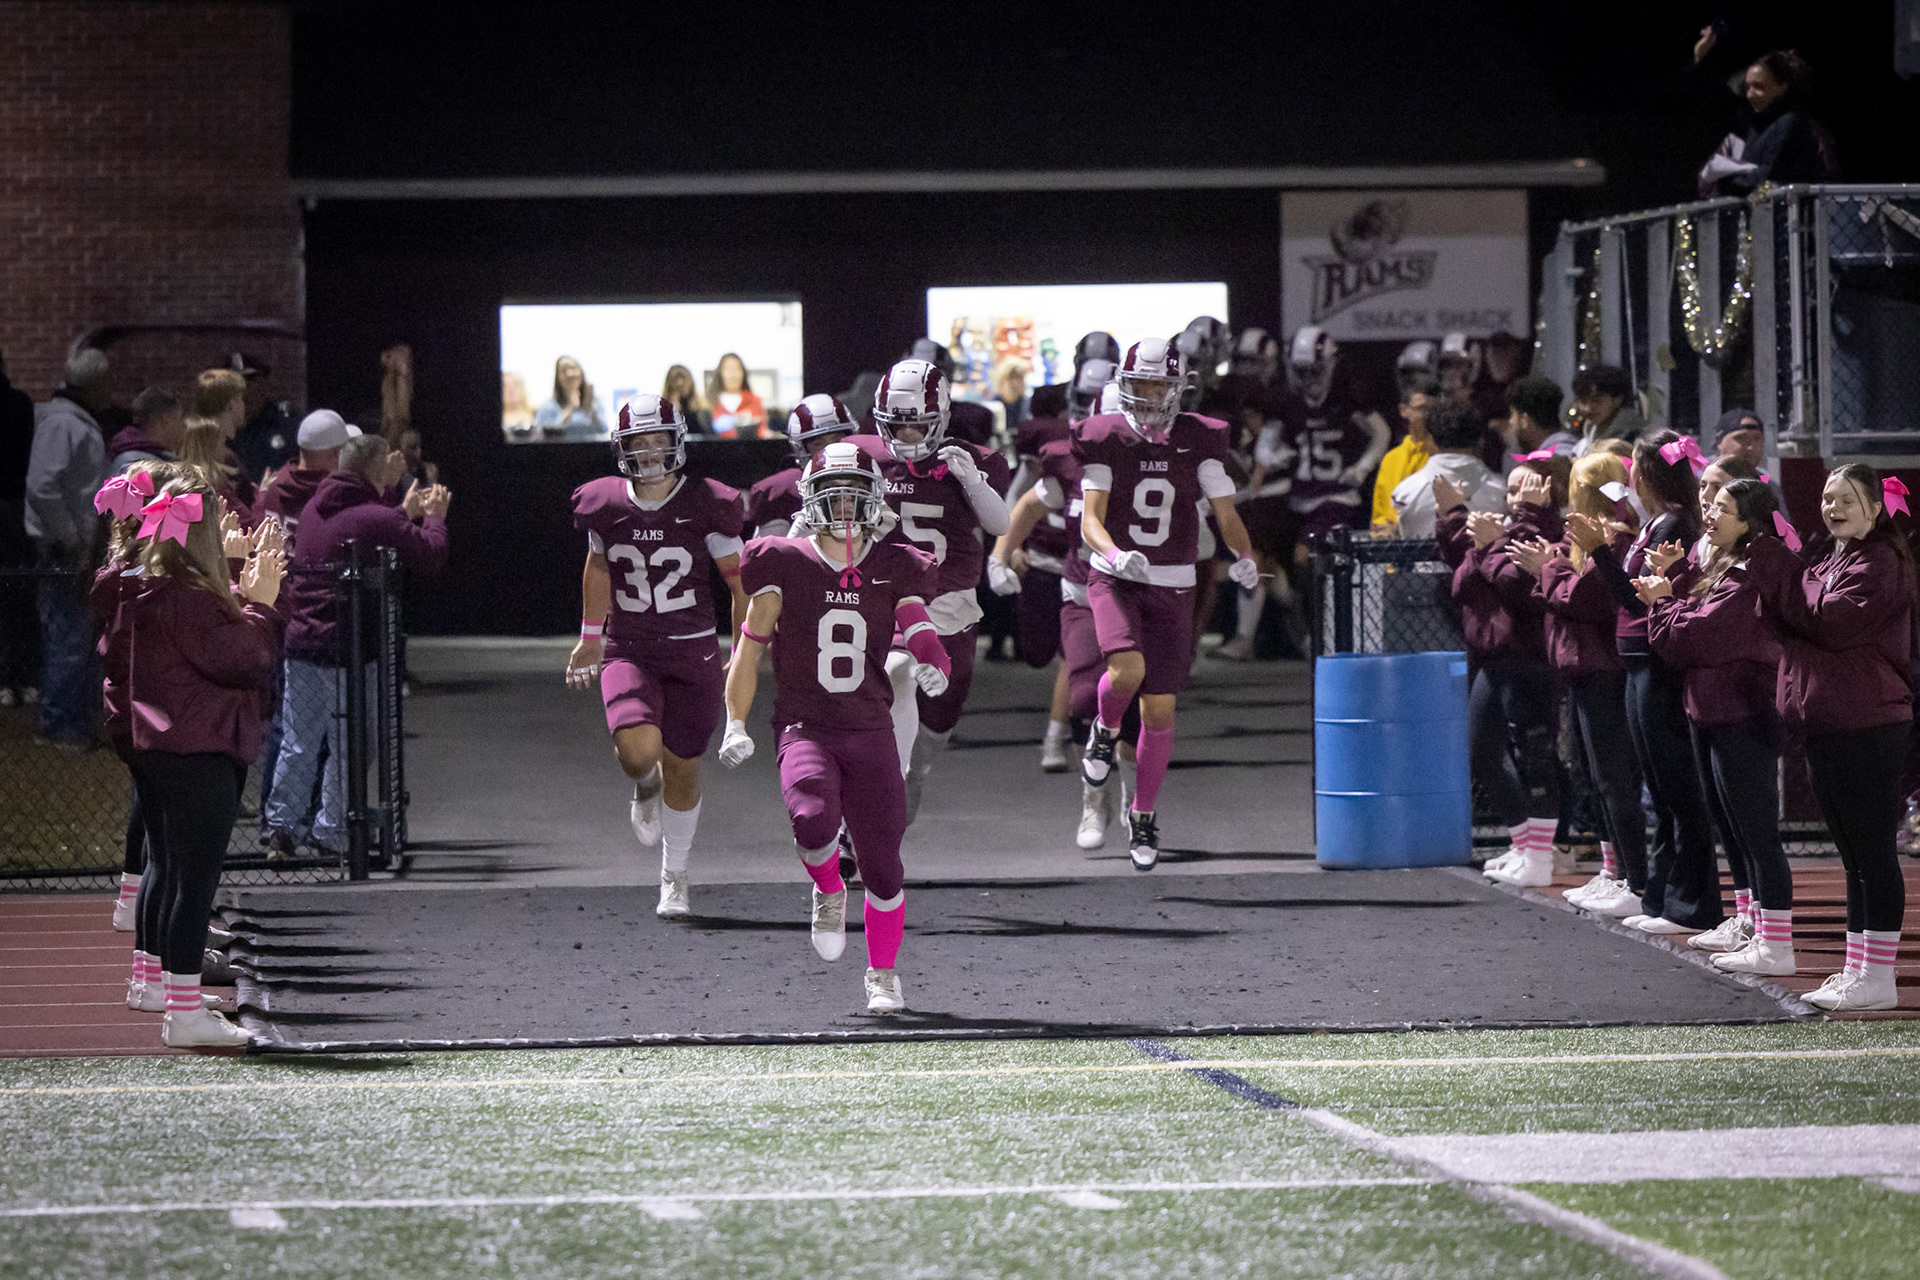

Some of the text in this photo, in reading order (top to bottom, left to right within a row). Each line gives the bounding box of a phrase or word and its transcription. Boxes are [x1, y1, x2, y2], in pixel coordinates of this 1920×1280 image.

[1312, 254, 1433, 313] RAMS
[1139, 460, 1169, 472] RAMS
[1295, 430, 1343, 481] 15
[885, 482, 915, 494] RAMS
[1128, 477, 1176, 547] 9
[632, 529, 664, 541] RAMS
[607, 543, 698, 614] 32
[824, 590, 860, 605] RAMS
[817, 608, 867, 693] 8
